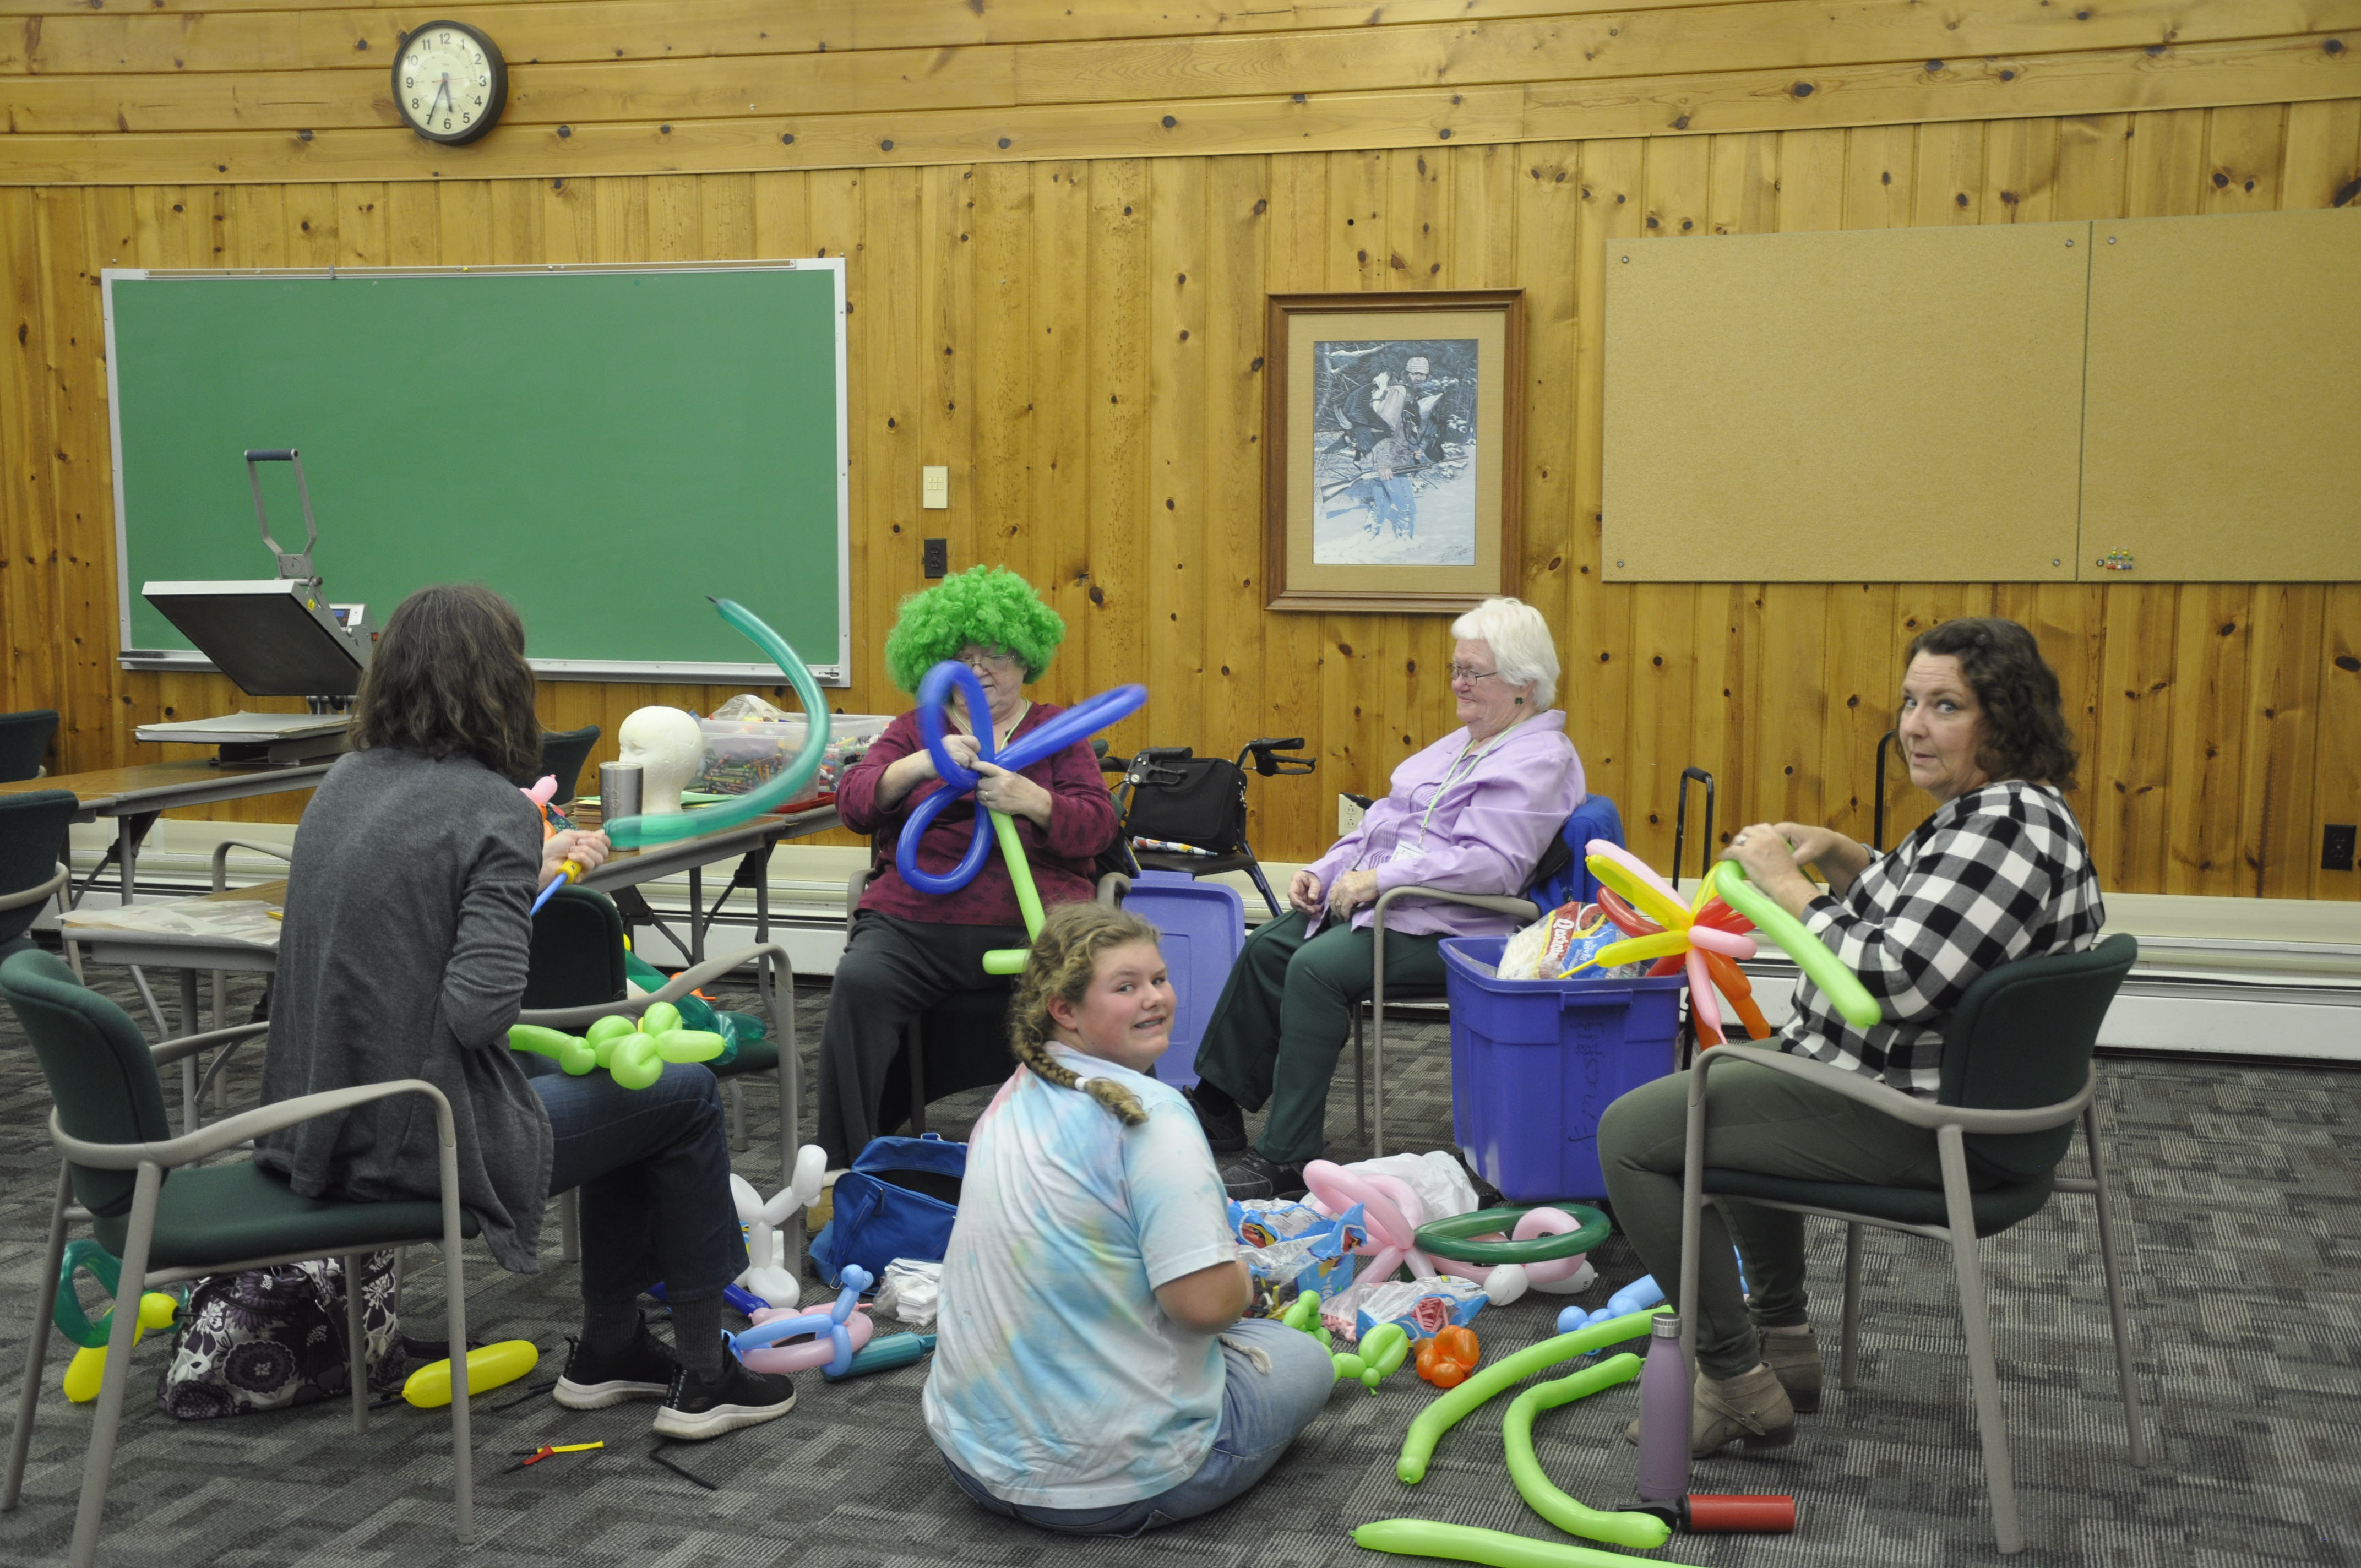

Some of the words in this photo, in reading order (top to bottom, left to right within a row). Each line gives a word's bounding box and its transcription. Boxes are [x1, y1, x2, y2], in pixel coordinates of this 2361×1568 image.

[421, 39, 431, 50] 11
[439, 33, 451, 45] 12
[461, 39, 465, 50] 1
[406, 55, 418, 66] 10
[474, 53, 482, 64] 2
[406, 77, 414, 88] 9
[479, 75, 487, 86] 3
[412, 98, 420, 109] 8
[474, 95, 482, 106] 4
[426, 114, 433, 125] 7
[463, 112, 470, 123] 5
[444, 118, 451, 129] 6
